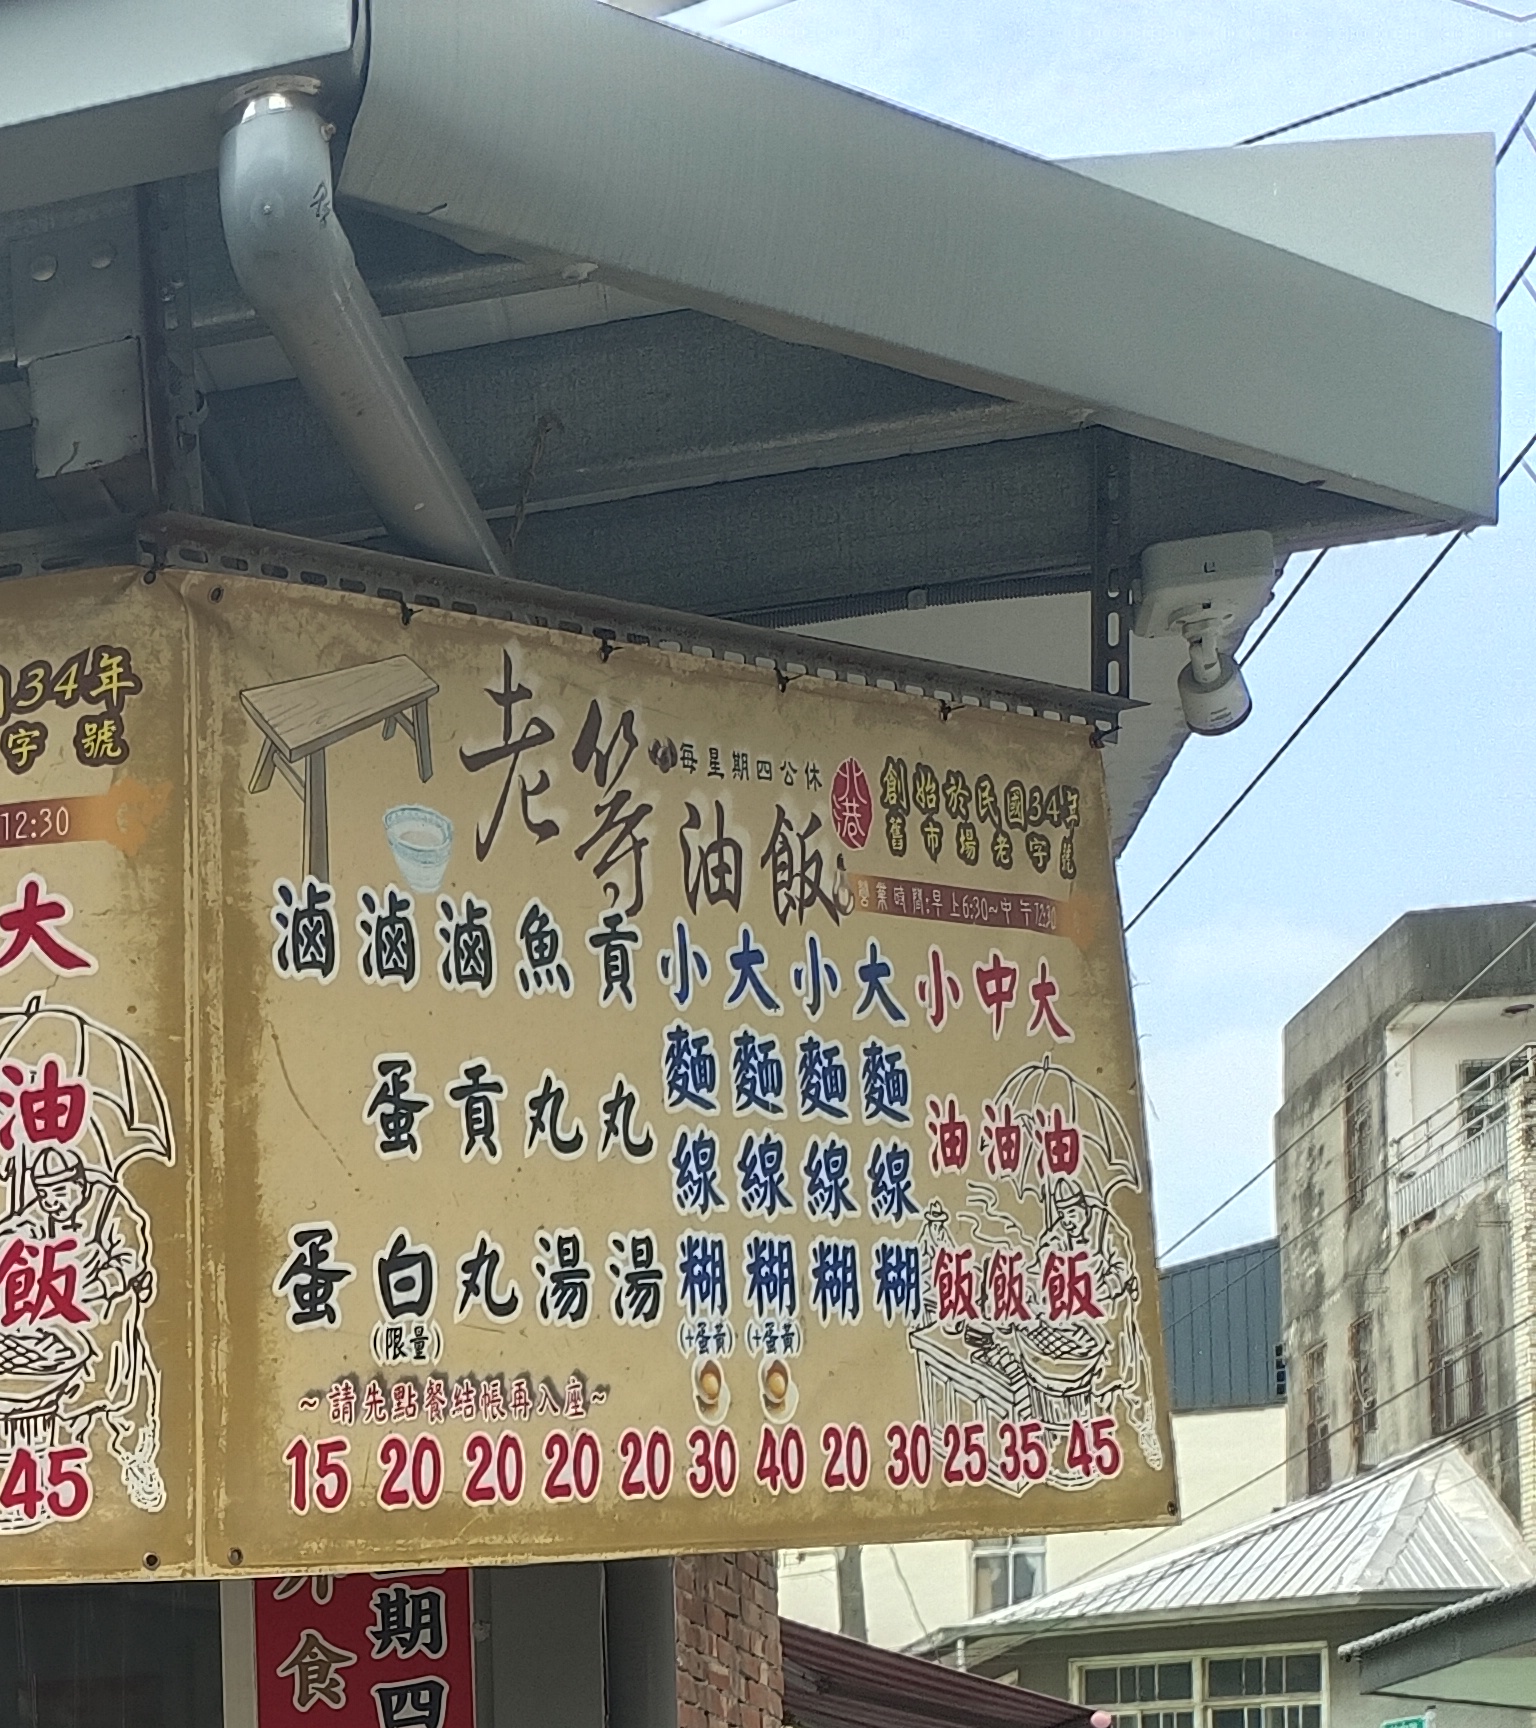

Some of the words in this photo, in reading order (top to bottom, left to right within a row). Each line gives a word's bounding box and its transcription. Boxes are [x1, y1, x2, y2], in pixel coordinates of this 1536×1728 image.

[678, 742, 824, 793] 每星期四公休
[882, 760, 1080, 831] 創始於民國34年
[831, 756, 873, 850] 北港
[374, 1325, 443, 1362] (限量)
[680, 1320, 734, 1358] (+蛋黃)
[747, 1320, 802, 1358] (+蛋黃)
[0, 1447, 89, 1520] 45
[285, 1439, 349, 1511] 15
[380, 1436, 442, 1507] 20
[465, 1433, 523, 1502] 20
[544, 1430, 600, 1500] 20
[620, 1428, 670, 1498] 20
[689, 1429, 736, 1492] 30
[757, 1427, 804, 1491] 40
[824, 1427, 868, 1487] 20
[887, 1426, 928, 1486] 30
[943, 1424, 987, 1484] 25
[999, 1423, 1047, 1483] 35
[1068, 1420, 1120, 1480] 45
